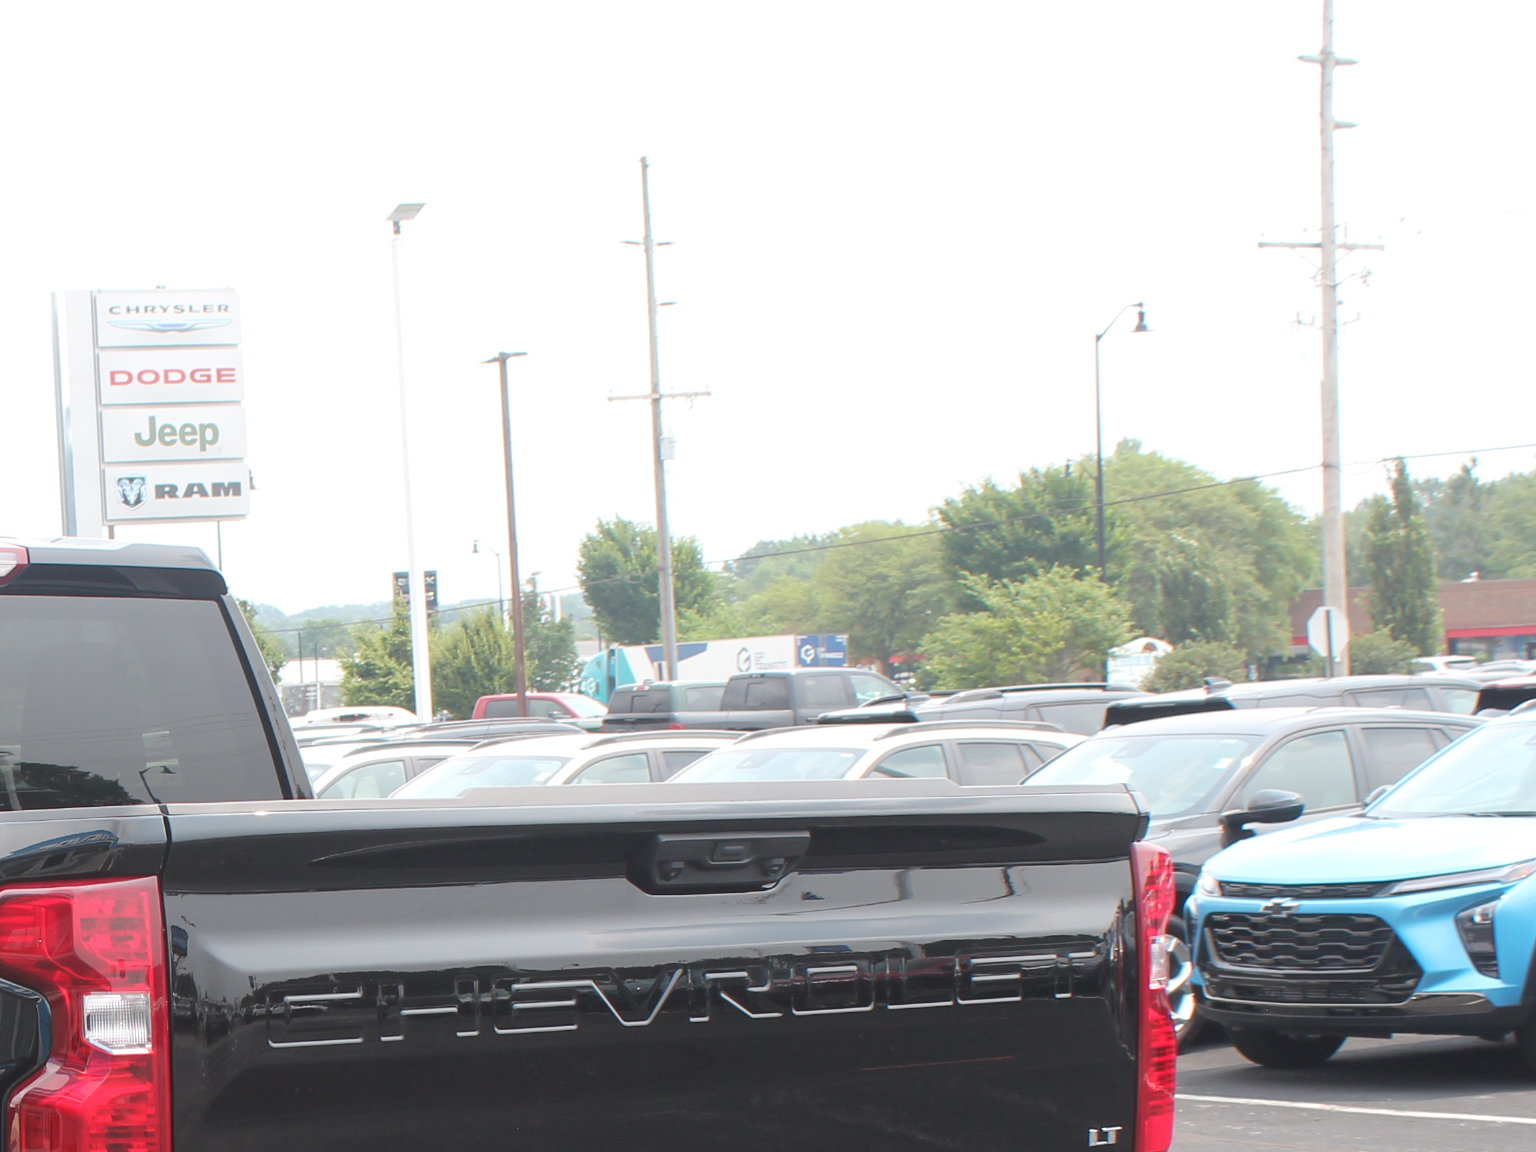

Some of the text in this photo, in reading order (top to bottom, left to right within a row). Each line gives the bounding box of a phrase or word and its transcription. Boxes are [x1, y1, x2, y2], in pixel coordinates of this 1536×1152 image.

[108, 304, 230, 315] CHRYSLER
[109, 368, 236, 386] DODGE
[134, 415, 220, 452] Jeep
[154, 481, 242, 499] RAM
[266, 947, 1097, 1048] CHEVROLET
[1088, 1126, 1123, 1147] LT
